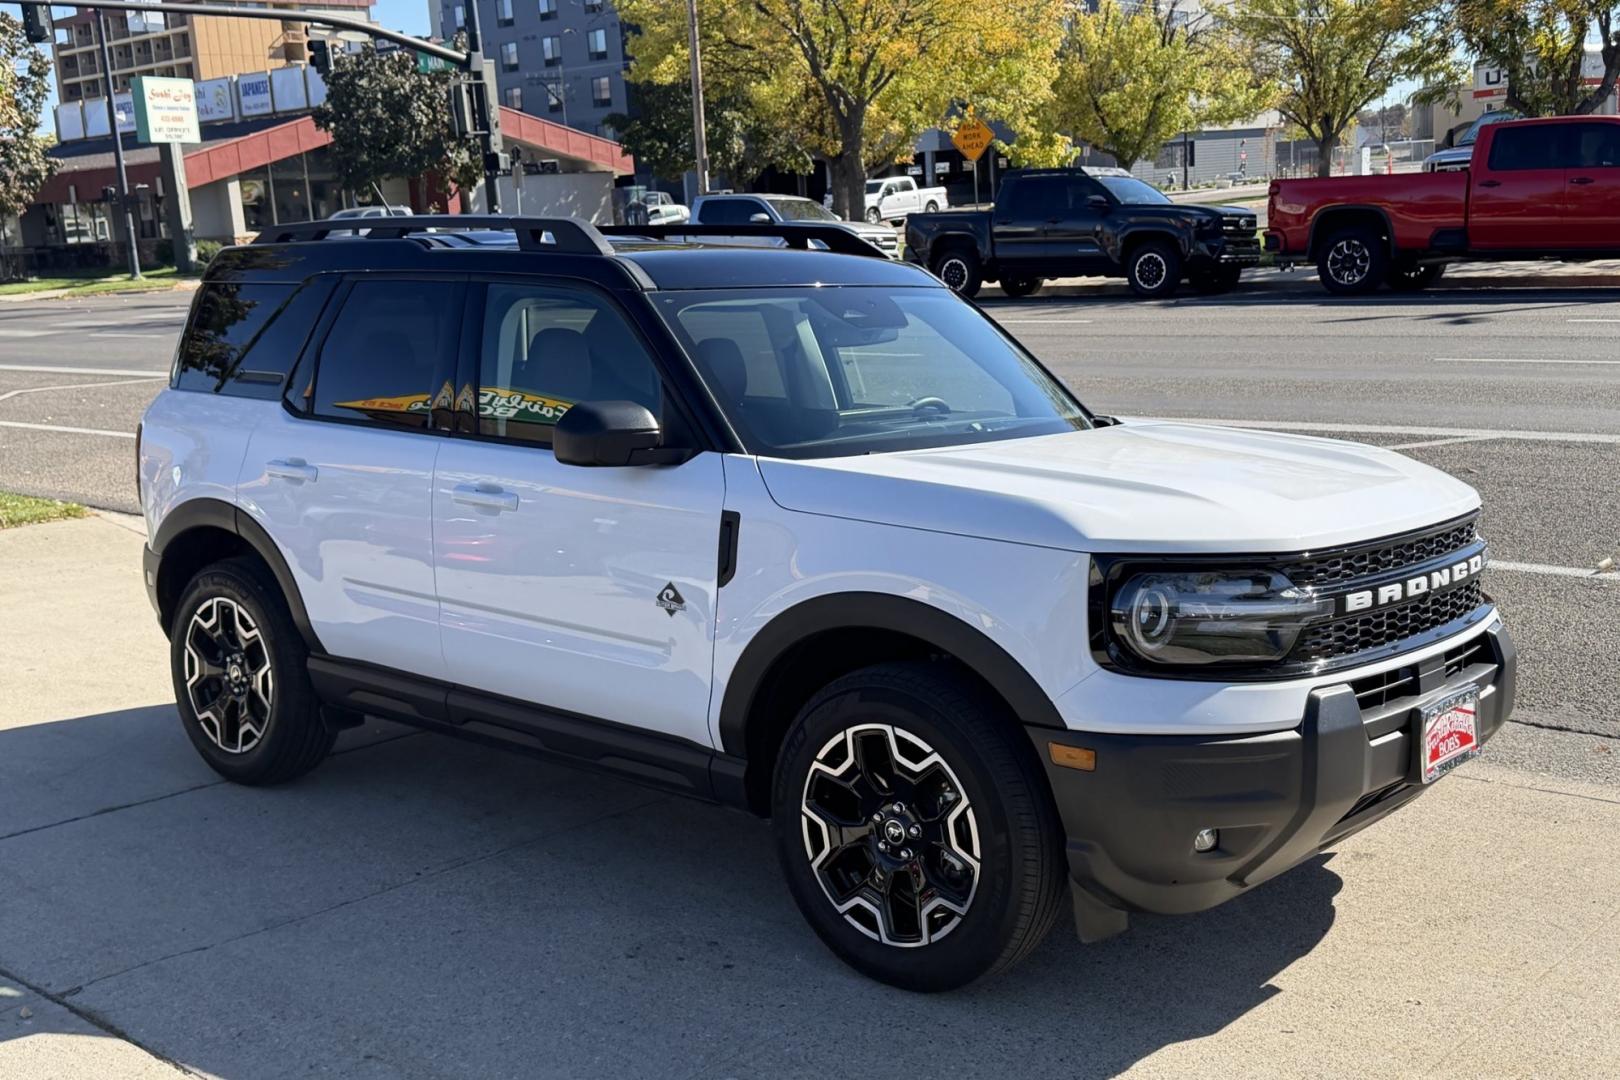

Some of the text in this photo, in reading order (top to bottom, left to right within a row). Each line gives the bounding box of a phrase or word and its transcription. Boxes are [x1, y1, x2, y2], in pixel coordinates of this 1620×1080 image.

[149, 88, 171, 101] Sushi
[241, 80, 269, 97] JAPANESE
[963, 132, 981, 140] WORK
[962, 141, 984, 149] AHEAD
[1345, 554, 1482, 613] BRONCO
